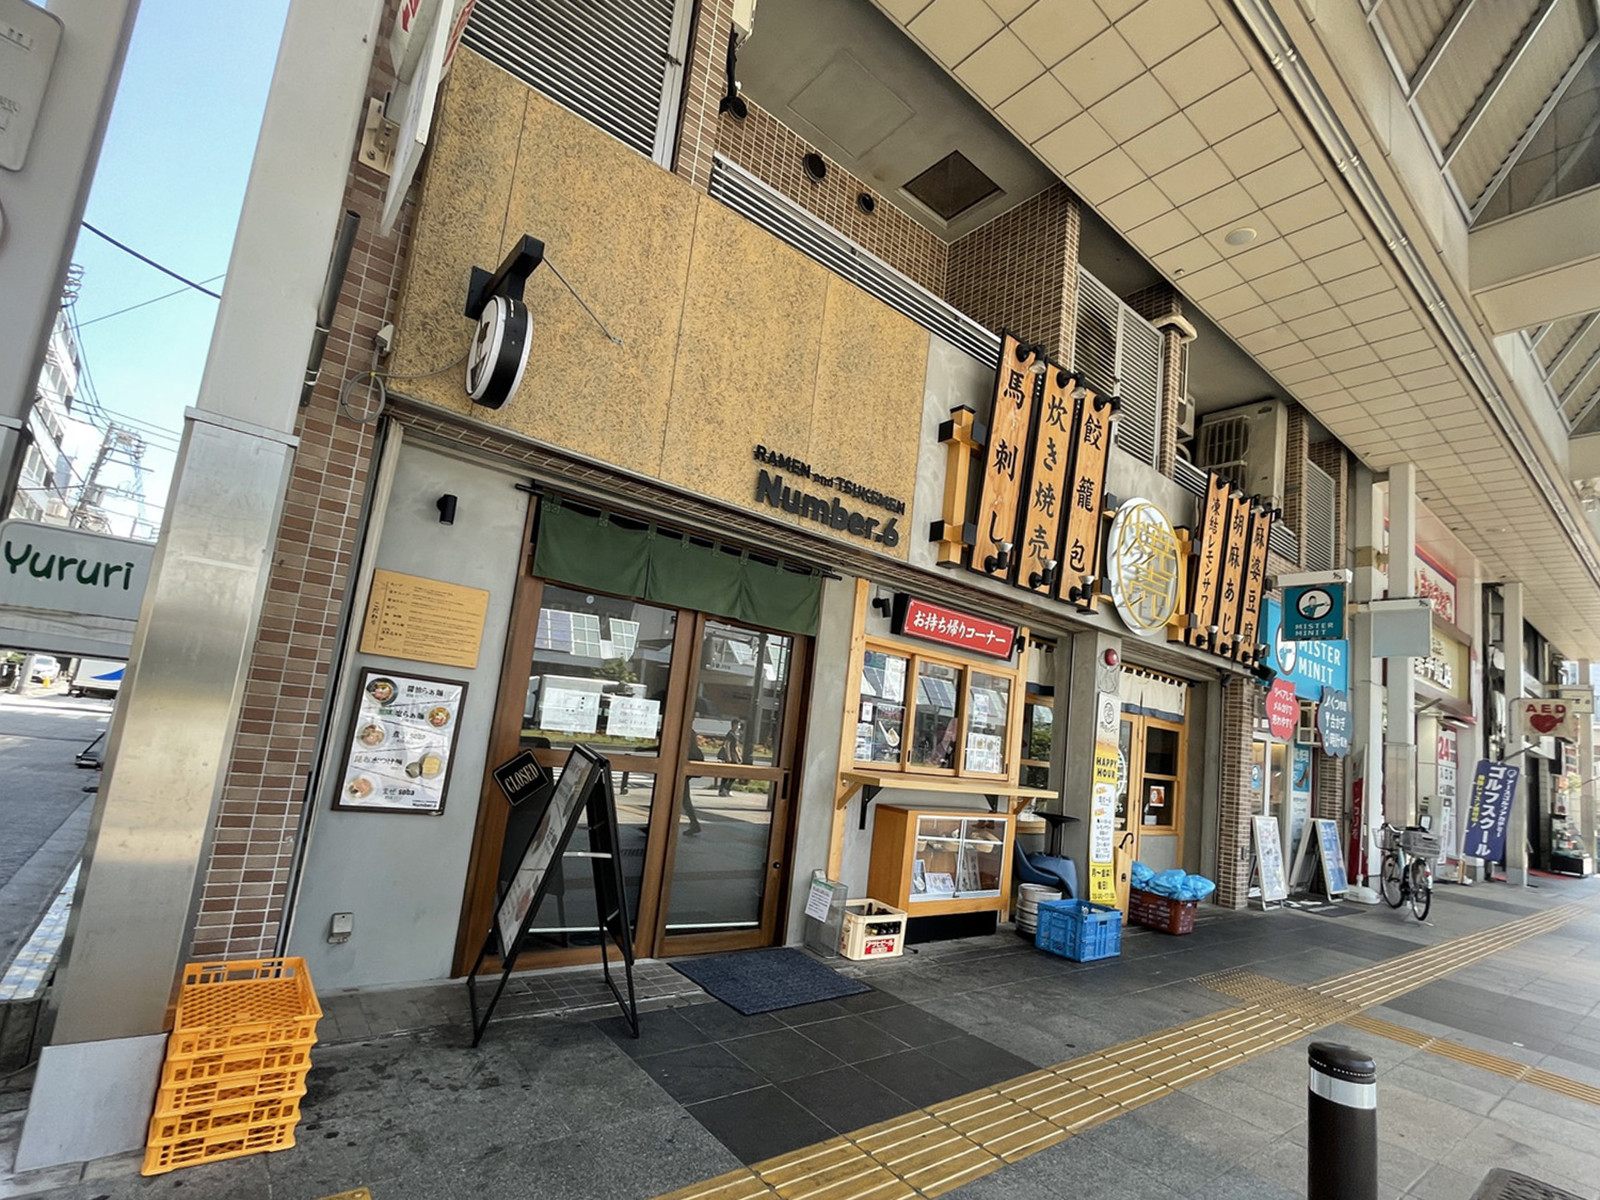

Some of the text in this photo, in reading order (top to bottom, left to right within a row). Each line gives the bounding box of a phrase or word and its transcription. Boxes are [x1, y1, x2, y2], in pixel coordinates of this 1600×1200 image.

[989, 369, 1026, 543] 馬刺し
[753, 444, 905, 515] RAMEN and TSUKEMEN
[1028, 394, 1067, 561] 炊き焼売
[756, 469, 899, 547] Number.6
[5, 541, 135, 590] Yururi
[1200, 497, 1221, 625] 凍結レモンサワー
[1222, 509, 1243, 636] 胡麻あじ
[1242, 523, 1264, 646] 麻婆豆腐
[913, 610, 1006, 645] お持ち帰りコーナー
[1295, 622, 1334, 630] MISTER
[1295, 629, 1327, 637] MINIT
[1298, 656, 1334, 685] MINIT
[1299, 640, 1341, 667] MISTER
[1526, 704, 1566, 714] AED
[504, 763, 539, 794] CLOSED
[1096, 757, 1117, 769] HAPPY
[1097, 768, 1116, 779] HOUR
[1475, 766, 1507, 856] ゴルフスクール
